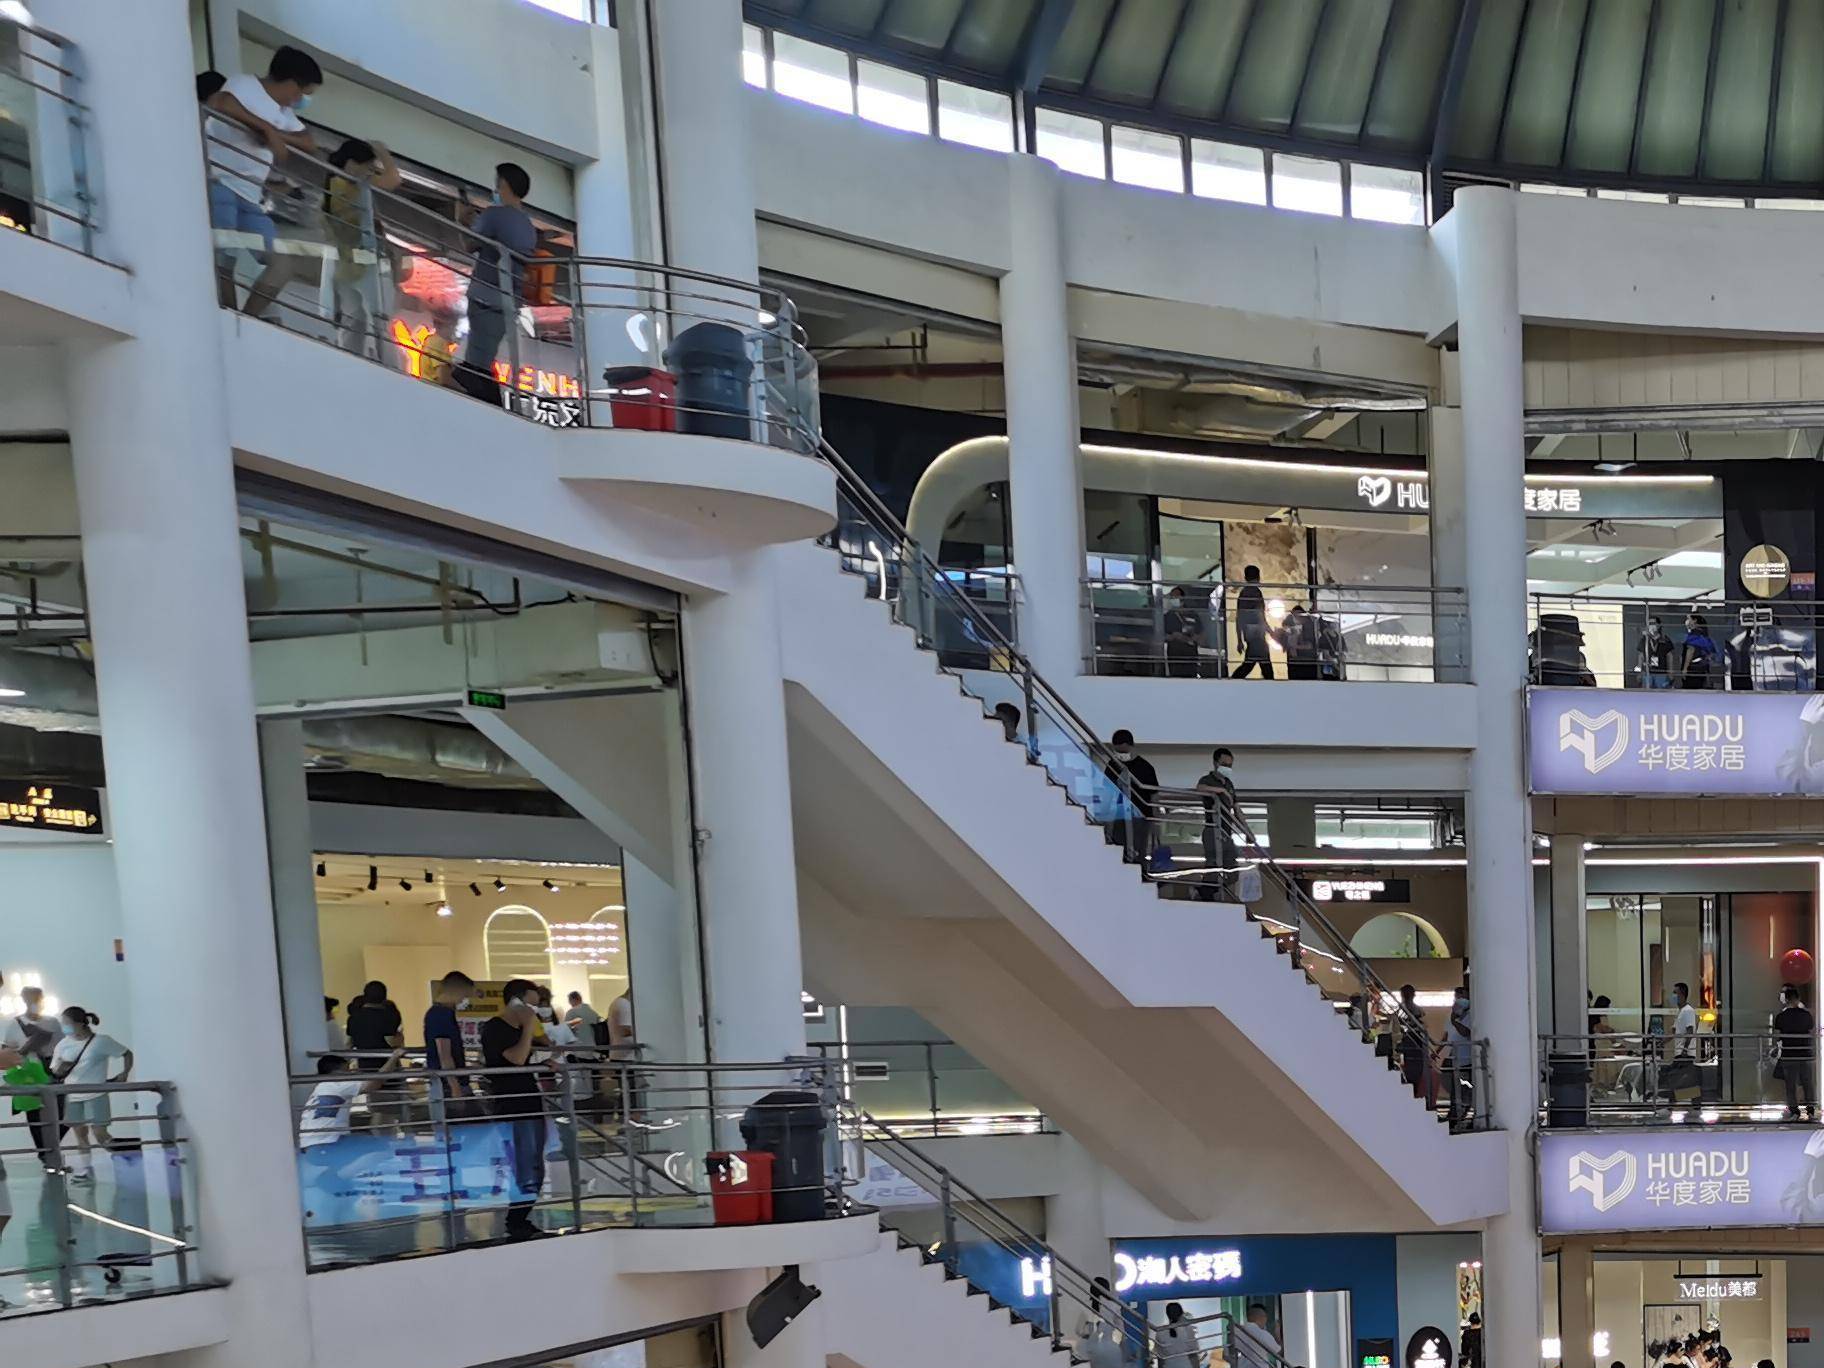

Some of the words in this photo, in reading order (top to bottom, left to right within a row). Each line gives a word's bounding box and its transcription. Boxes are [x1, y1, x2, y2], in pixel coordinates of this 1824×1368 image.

[1640, 714, 1744, 742] HUADU
[1637, 744, 1746, 771] 华度家居
[1647, 1150, 1749, 1178] HUADU
[1645, 1179, 1751, 1207] 华度家居
